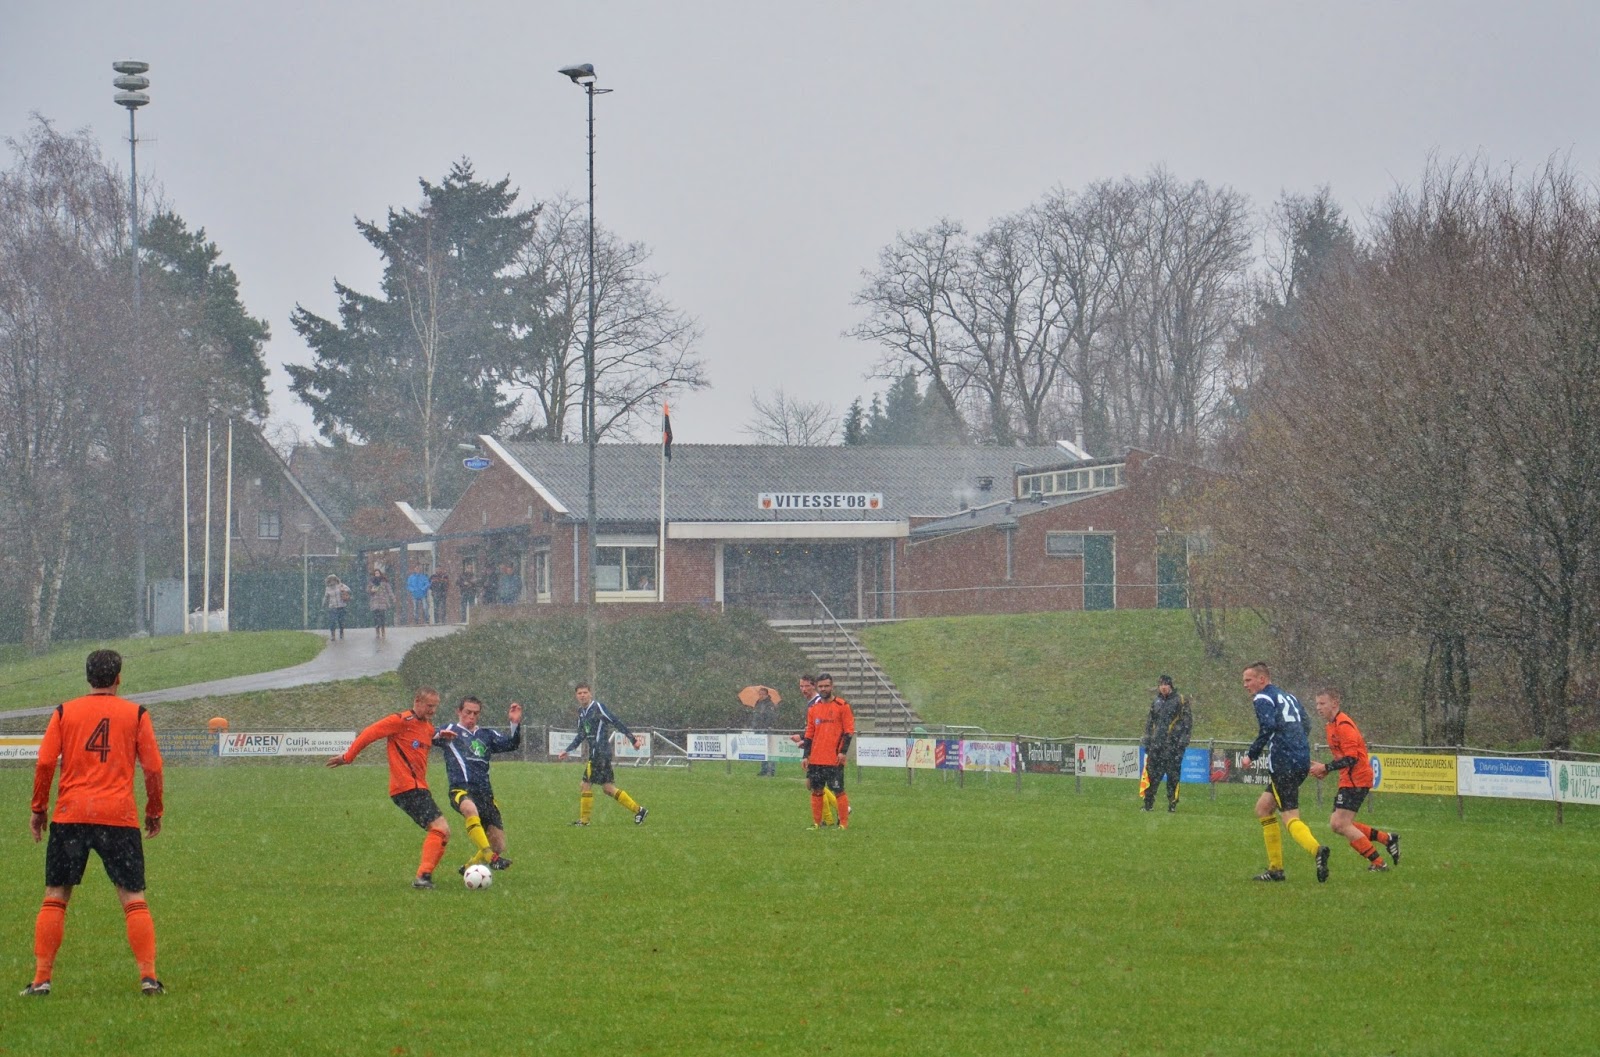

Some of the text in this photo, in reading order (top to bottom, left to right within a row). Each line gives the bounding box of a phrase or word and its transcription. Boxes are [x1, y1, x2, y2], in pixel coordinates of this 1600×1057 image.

[775, 495, 866, 508] VITESSE'08
[85, 717, 111, 763] 4
[285, 737, 310, 747] Cuijk
[1087, 745, 1101, 761] noy
[1095, 762, 1116, 776] logistics
[1479, 761, 1524, 773] Danny Palacios
